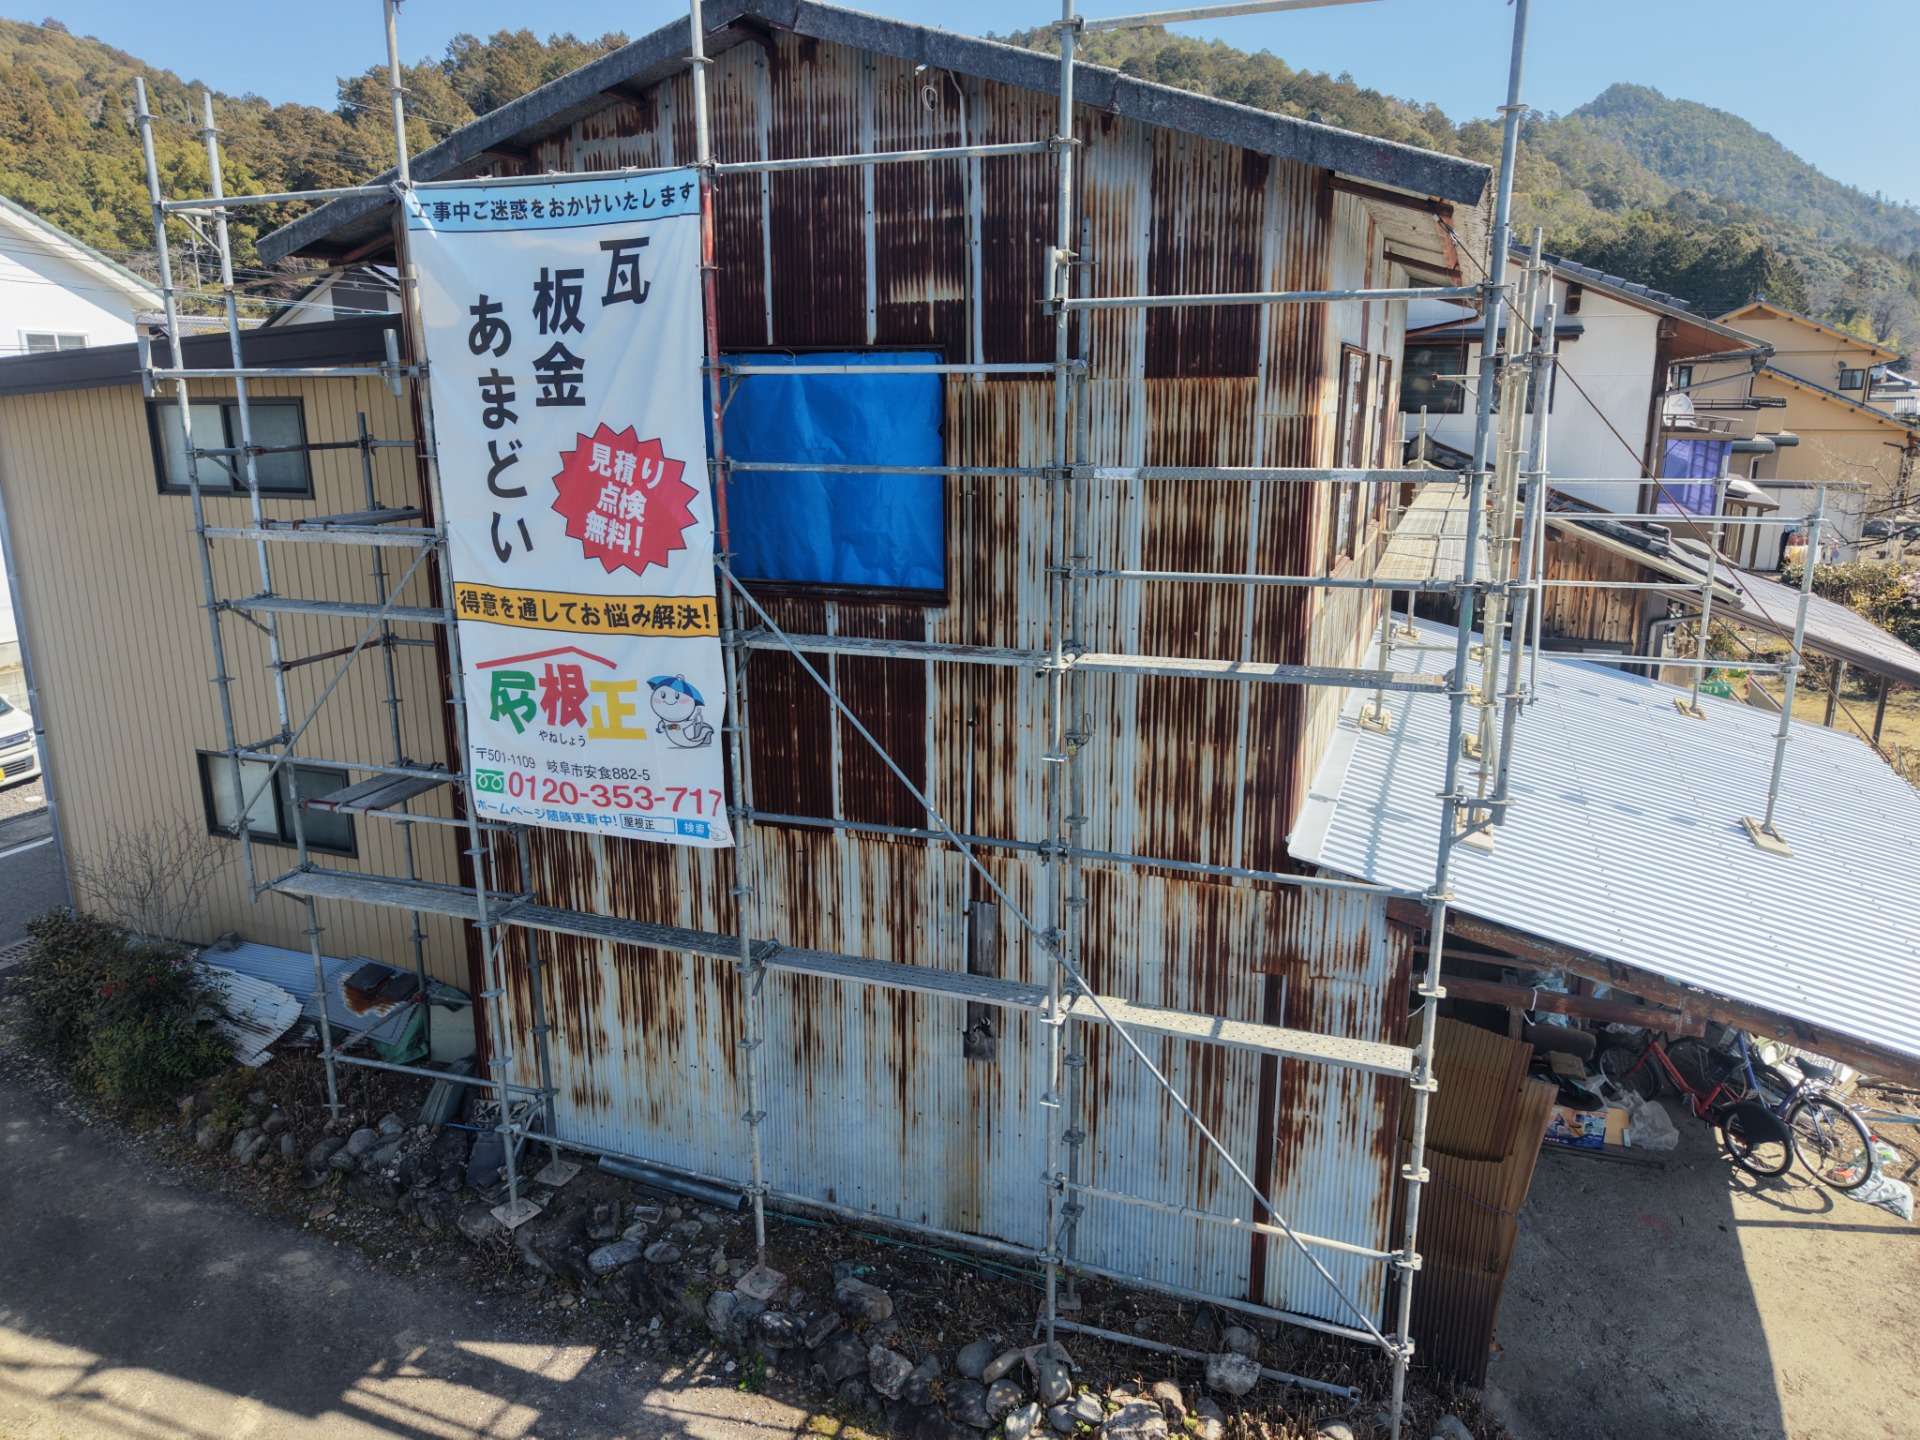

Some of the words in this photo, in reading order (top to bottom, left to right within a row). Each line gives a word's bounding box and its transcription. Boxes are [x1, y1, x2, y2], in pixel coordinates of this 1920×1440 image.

[599, 236, 651, 307] 瓦
[532, 266, 586, 407] 板金
[468, 294, 533, 564] あまどい
[588, 442, 665, 489] 見積り
[597, 485, 647, 523] 点検
[584, 510, 643, 557] 無料!
[458, 589, 711, 630] 得意を通してお悩み解決!
[538, 729, 586, 748] やねしょう
[546, 760, 650, 780] 岐阜市安食882-5
[508, 771, 722, 817] 0120-353-717
